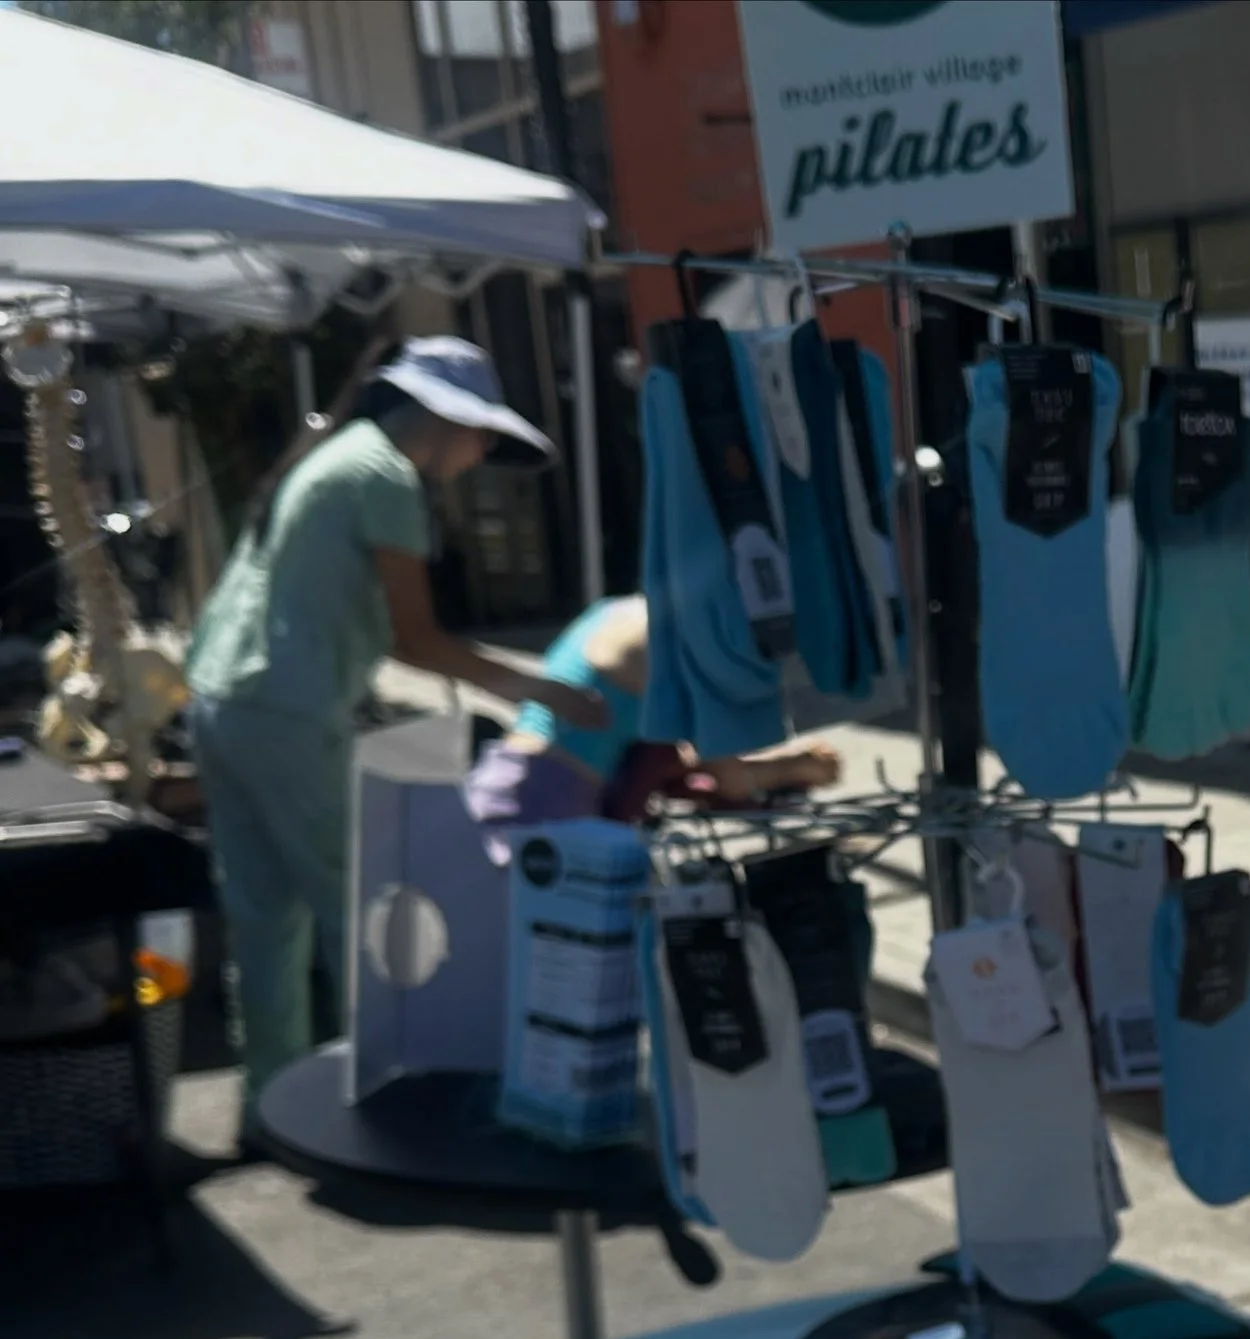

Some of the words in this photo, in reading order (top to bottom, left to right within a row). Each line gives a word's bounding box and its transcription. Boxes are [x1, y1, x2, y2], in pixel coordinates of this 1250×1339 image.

[780, 69, 915, 108] montclair
[924, 54, 1022, 86] village
[784, 99, 1047, 218] pilates
